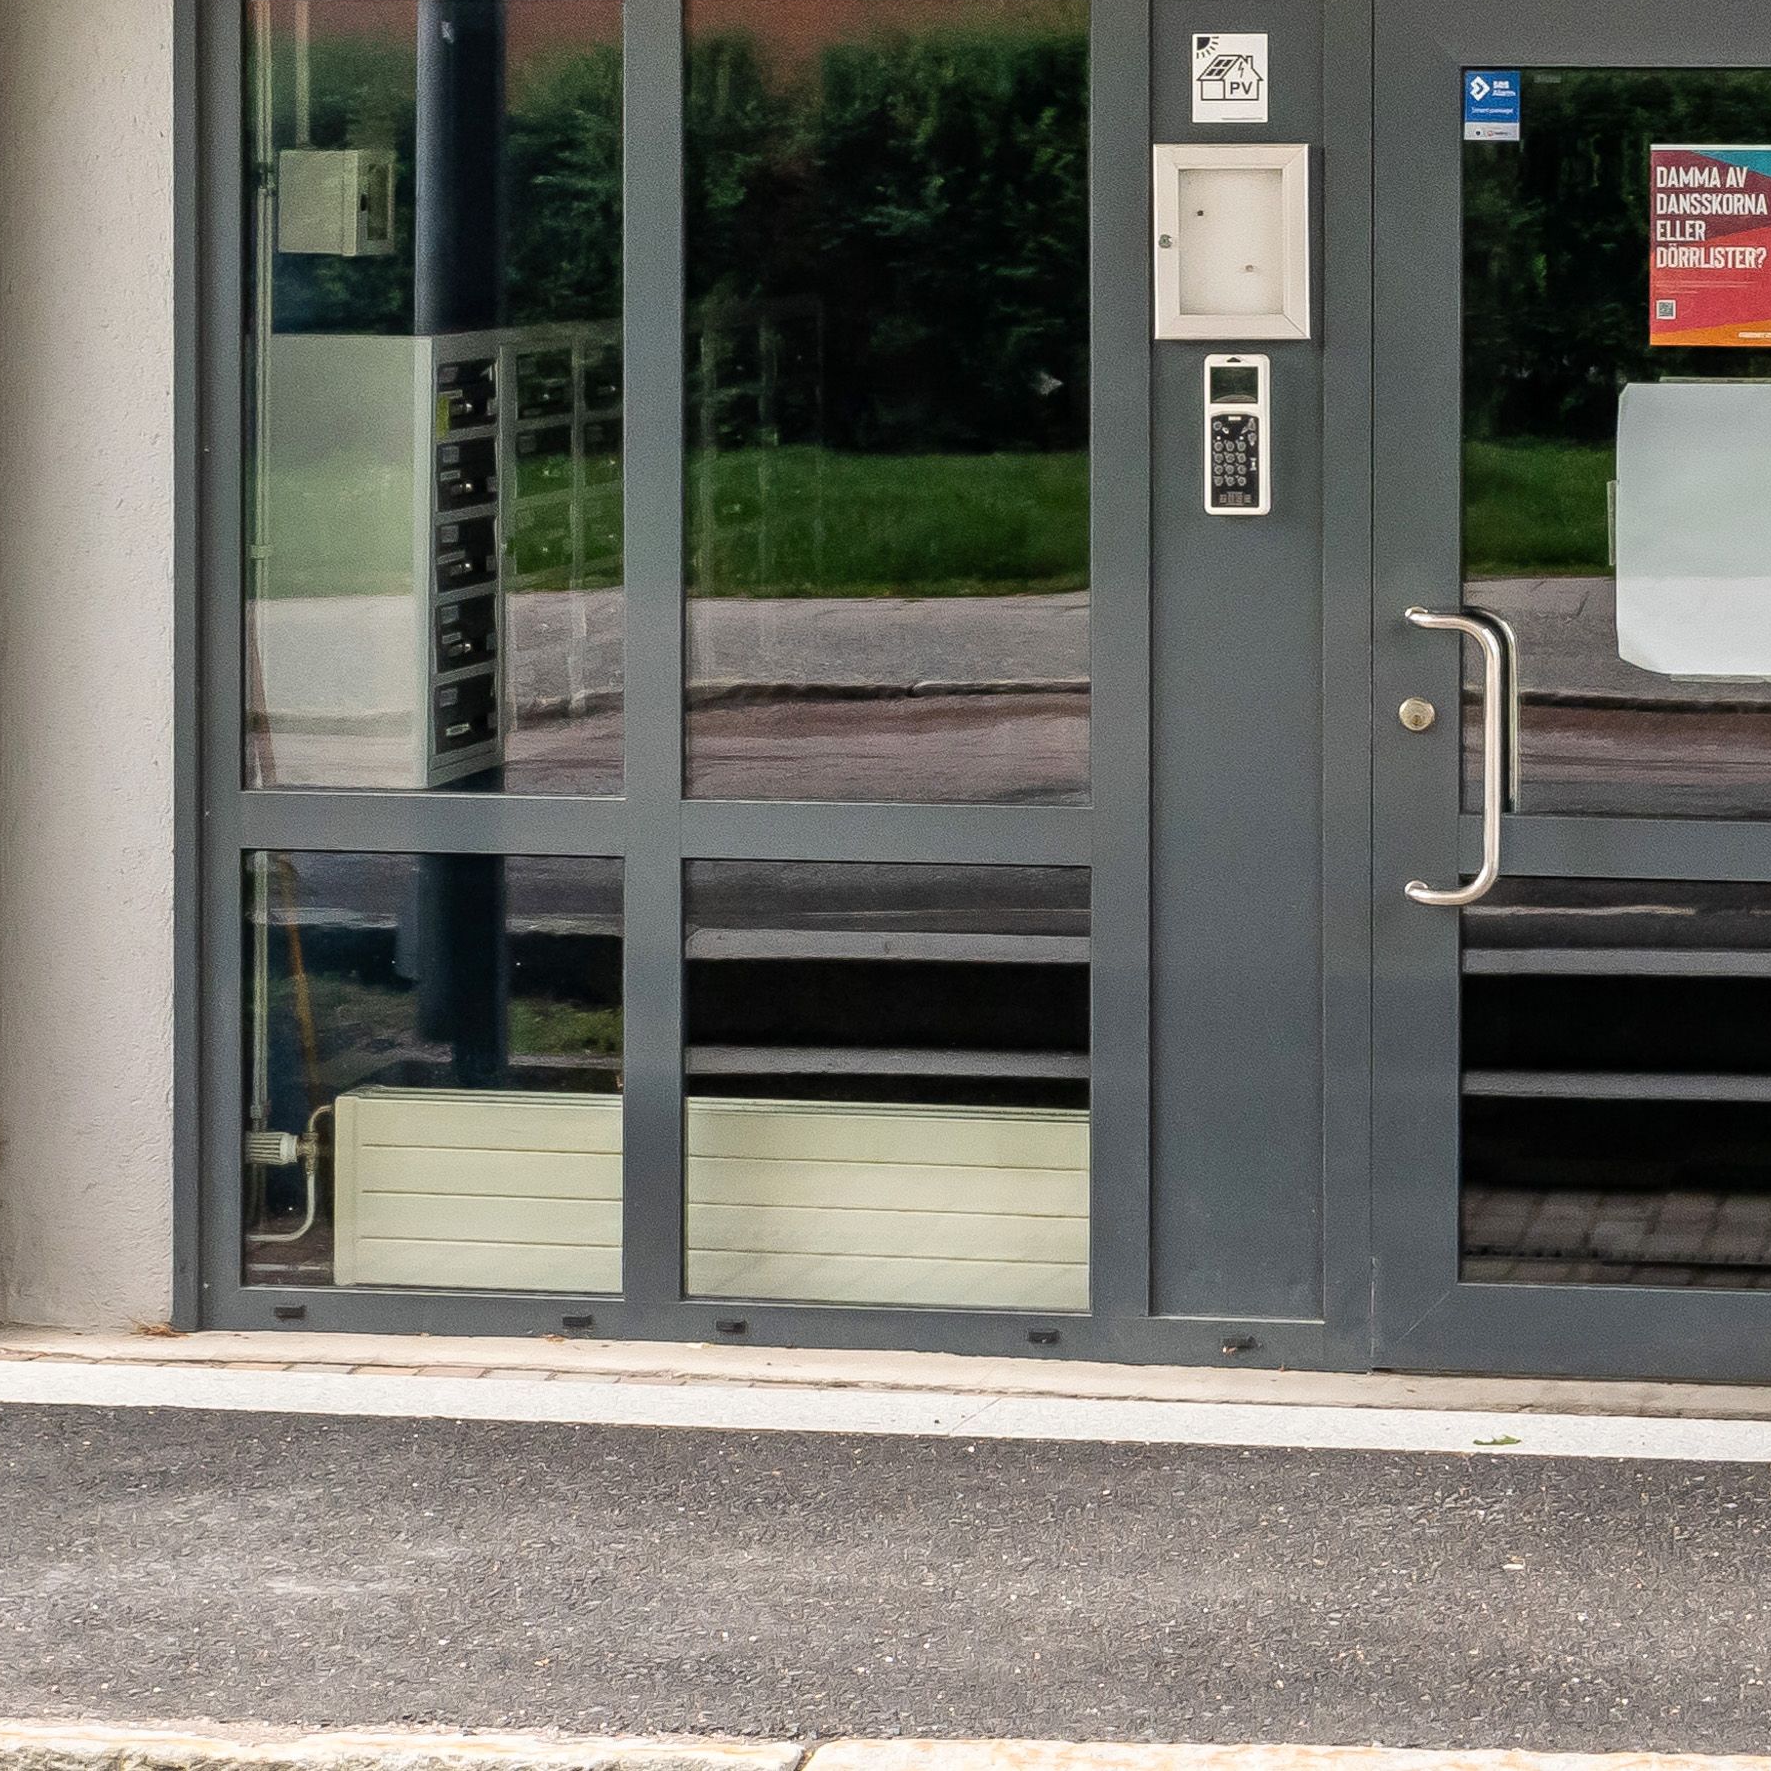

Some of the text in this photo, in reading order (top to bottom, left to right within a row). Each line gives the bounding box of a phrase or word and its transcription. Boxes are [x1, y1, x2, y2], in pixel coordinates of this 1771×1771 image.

[1230, 81, 1253, 95] PV
[1656, 166, 1748, 188] DAMMA AV
[1656, 193, 1768, 216] DANSSKORNA
[1656, 220, 1706, 241] ELLER
[1656, 244, 1767, 269] DÖRRLISTER?
